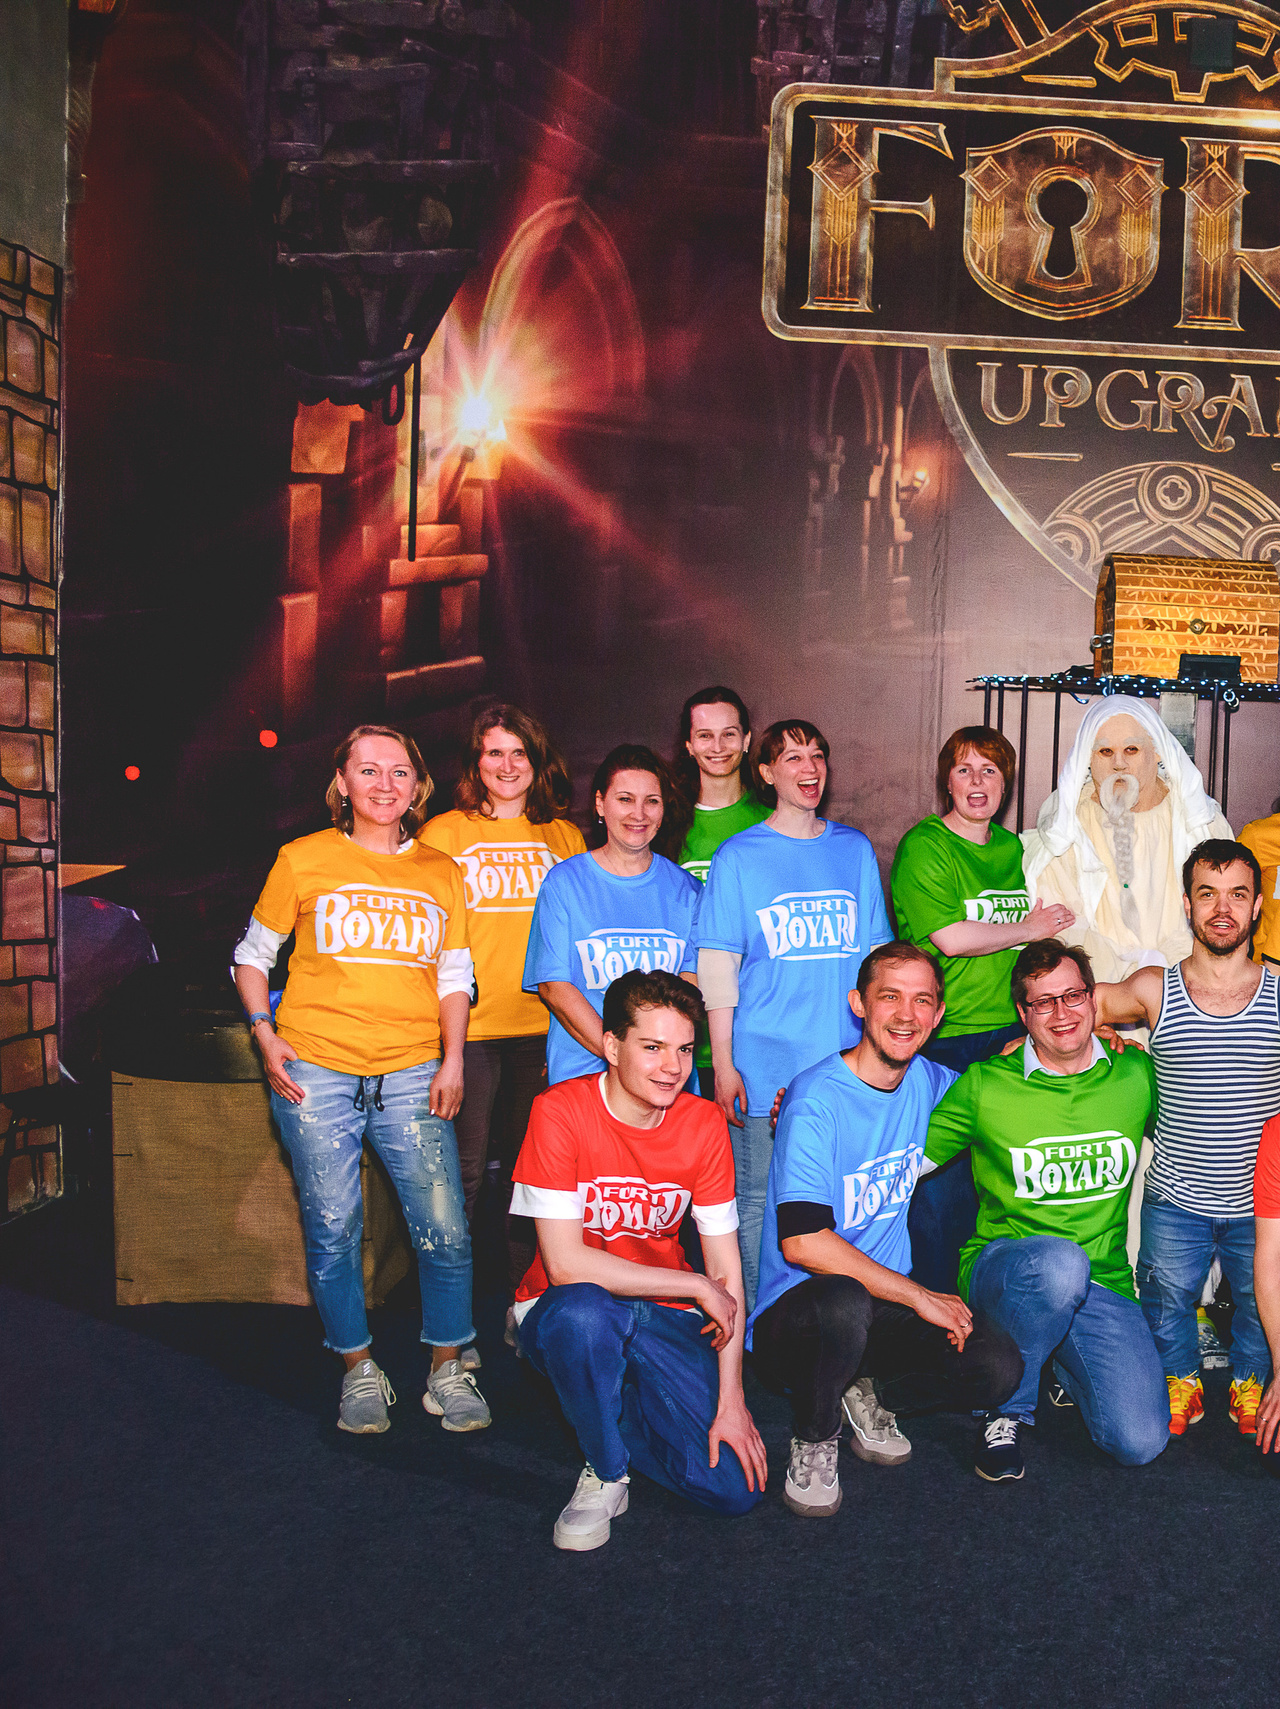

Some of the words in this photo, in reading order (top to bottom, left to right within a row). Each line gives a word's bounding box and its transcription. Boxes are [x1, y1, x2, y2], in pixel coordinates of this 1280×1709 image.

[479, 850, 536, 865] FORT
[351, 893, 418, 913] FORT
[789, 898, 845, 914] FORT
[993, 897, 1028, 909] FORT
[314, 893, 448, 964] BOYARD
[755, 898, 860, 960] BOYARD
[606, 936, 661, 949] FORT
[1045, 1141, 1106, 1161] FORT
[1009, 1136, 1137, 1199] BOYARD
[603, 1186, 662, 1204] FORT
